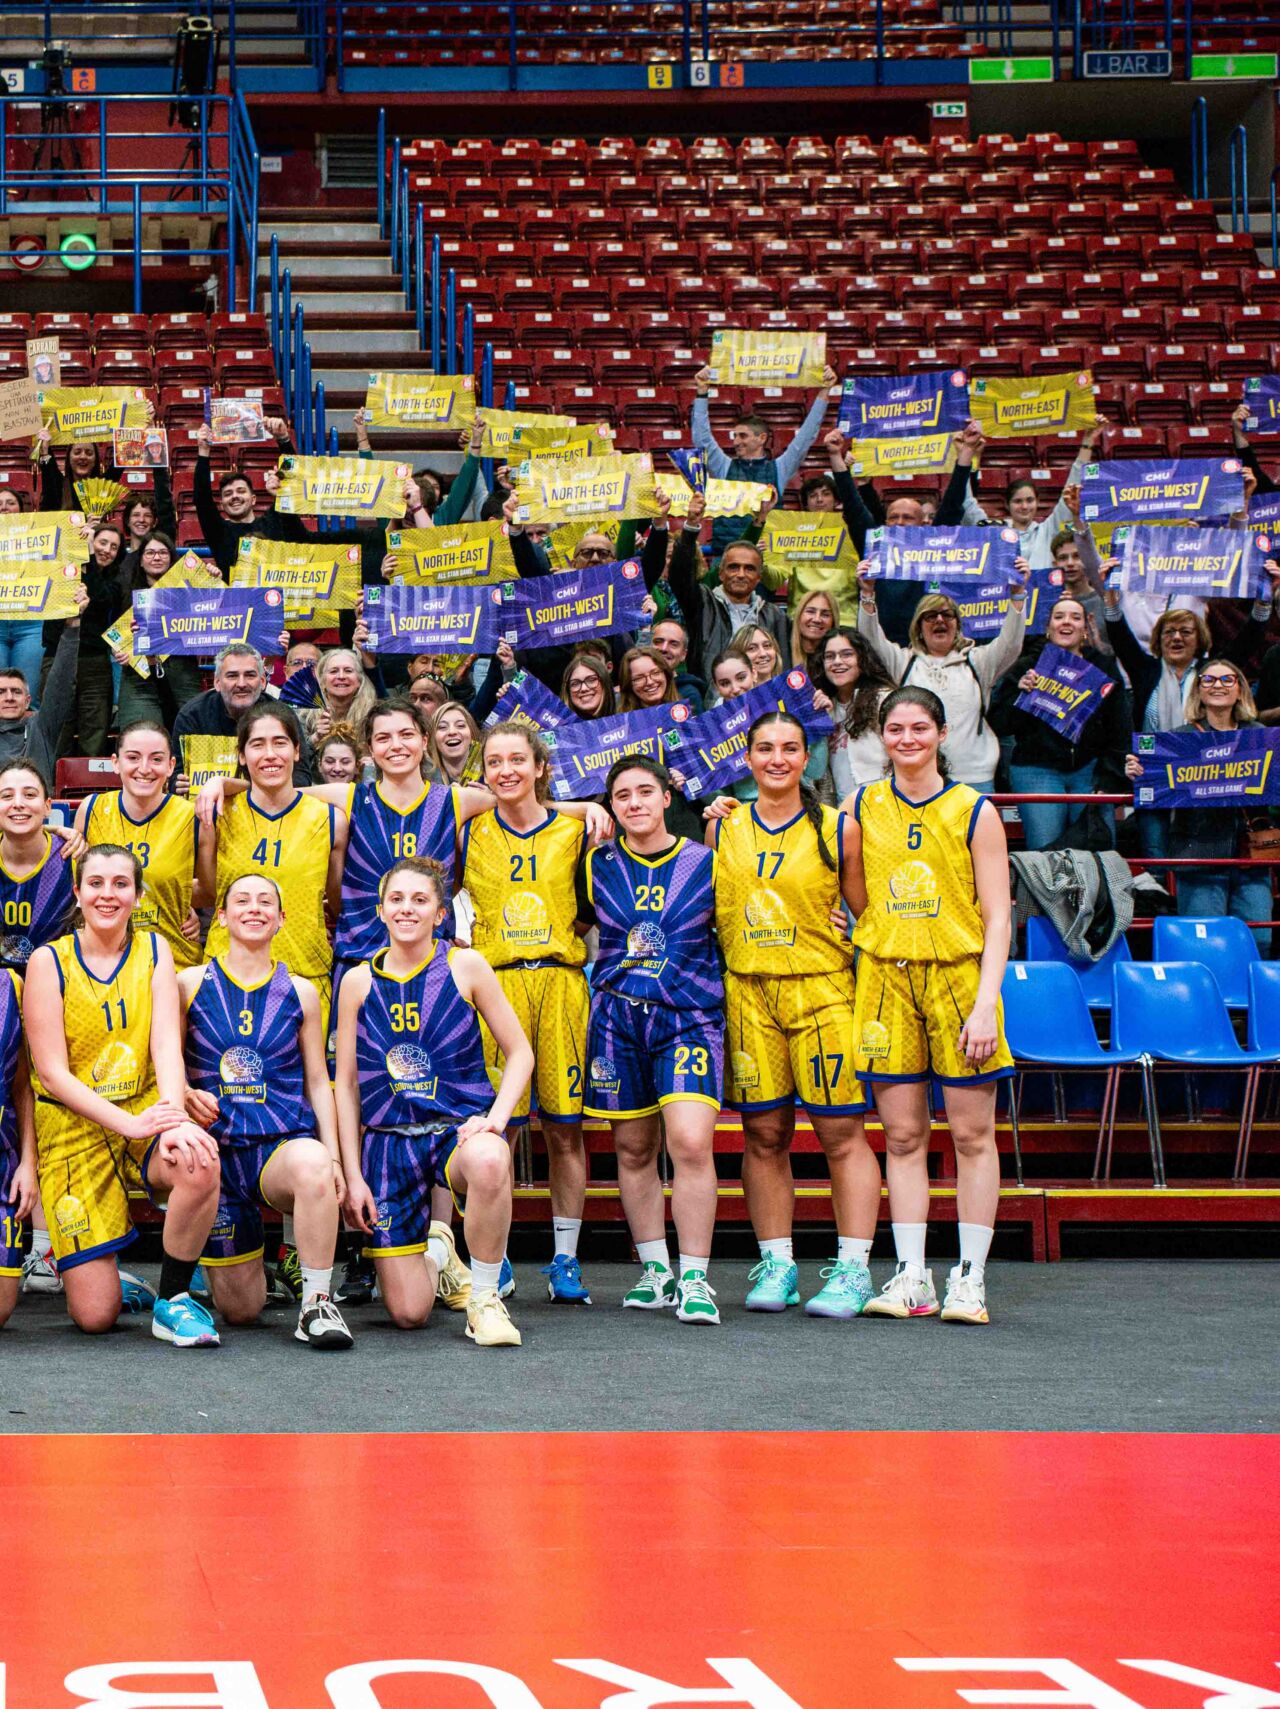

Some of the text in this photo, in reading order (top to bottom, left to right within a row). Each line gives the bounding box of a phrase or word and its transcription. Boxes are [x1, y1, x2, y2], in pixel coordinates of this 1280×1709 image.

[1109, 56, 1148, 74] BAR
[655, 67, 664, 78] B
[695, 67, 705, 81] 6
[8, 73, 18, 87] 5
[79, 79, 89, 90] C
[28, 340, 57, 356] CARRARO
[738, 354, 796, 367] NORTH-EAST
[891, 389, 910, 399] CMU
[391, 397, 446, 409] NORTH-EAST
[868, 399, 934, 419] SOUTH-WEST
[1001, 398, 1061, 417] NORTH-EAST
[62, 408, 117, 425] NORTH-EAST
[882, 440, 942, 458] NORTH-EAST
[1145, 472, 1170, 482] CMU
[311, 482, 373, 495] NORTH-EAST
[551, 481, 620, 500] NORTH-EAST
[1119, 482, 1198, 502] SOUTH-WEST
[1254, 507, 1278, 518] CMU
[442, 538, 461, 548] CMU
[776, 535, 836, 548] NORTH-EAST
[928, 538, 952, 546] CMU
[1176, 542, 1202, 551] CMU
[288, 557, 306, 565] CMU
[423, 547, 483, 569] NORTH-EAST
[902, 547, 980, 563] SOUTH-WEST
[1147, 555, 1230, 572] SOUTH-WEST
[264, 569, 328, 583] NORTH-EAST
[557, 586, 577, 599] CMU
[980, 586, 1003, 597] CMU
[194, 602, 217, 612] CMU
[423, 601, 445, 610] CMU
[536, 594, 605, 625] SOUTH-WEST
[170, 614, 243, 633] SOUTH-WEST
[398, 613, 471, 631] SOUTH-WEST
[187, 635, 227, 645] ALL STAR GAME
[1058, 667, 1077, 680] CMU
[725, 711, 747, 730] CMU
[603, 730, 625, 743] CMU
[711, 731, 748, 763] SOUTH-
[1205, 747, 1231, 759] CMU
[1176, 759, 1262, 784] SOUTH-WEST
[1195, 784, 1243, 796] ALL STAR GAME
[907, 823, 922, 851] 5
[391, 832, 417, 858] 18
[252, 838, 281, 867] 41
[510, 855, 537, 882] 21
[756, 851, 785, 879] 17
[634, 885, 665, 911] 23
[891, 899, 936, 911] NORTH-EAST
[4, 901, 31, 926] 00
[506, 928, 547, 939] NORTH-EAST
[749, 928, 791, 940] NORTH-EAST
[620, 958, 663, 970] SOUTH-WEST
[101, 998, 126, 1031] 11
[390, 1002, 420, 1033] 35
[239, 1009, 252, 1036] 3
[674, 1046, 708, 1076] 23
[809, 1053, 844, 1089] 17
[223, 1084, 263, 1095] SOUTH-WEST
[393, 1080, 433, 1092] SOUTH-WEST
[3, 1215, 22, 1248] 12
